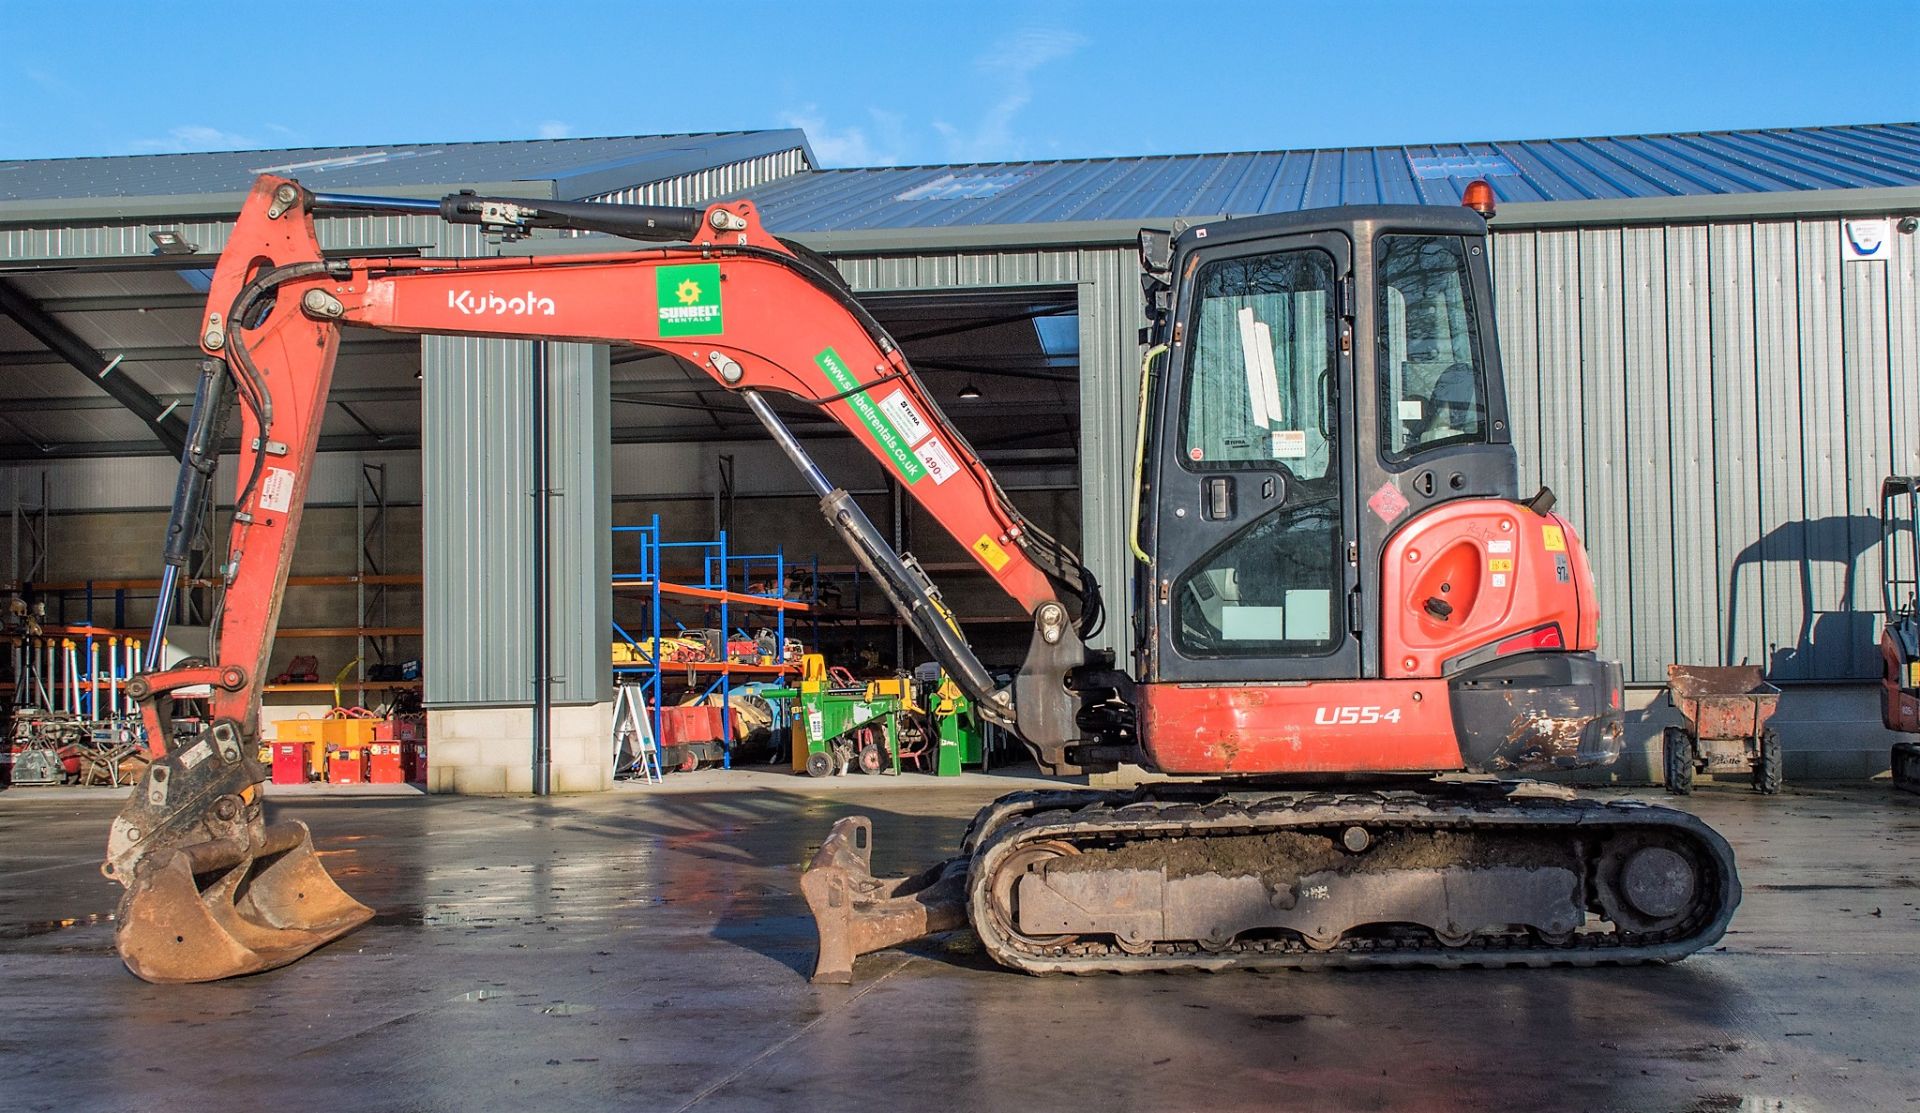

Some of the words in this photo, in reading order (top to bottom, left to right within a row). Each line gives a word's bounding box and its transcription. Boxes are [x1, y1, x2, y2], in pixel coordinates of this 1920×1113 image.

[448, 289, 555, 315] Kubota
[659, 305, 719, 319] SUNBELT
[925, 456, 941, 475] 490
[1557, 566, 1566, 581] 97
[1314, 706, 1401, 725] U55-4
